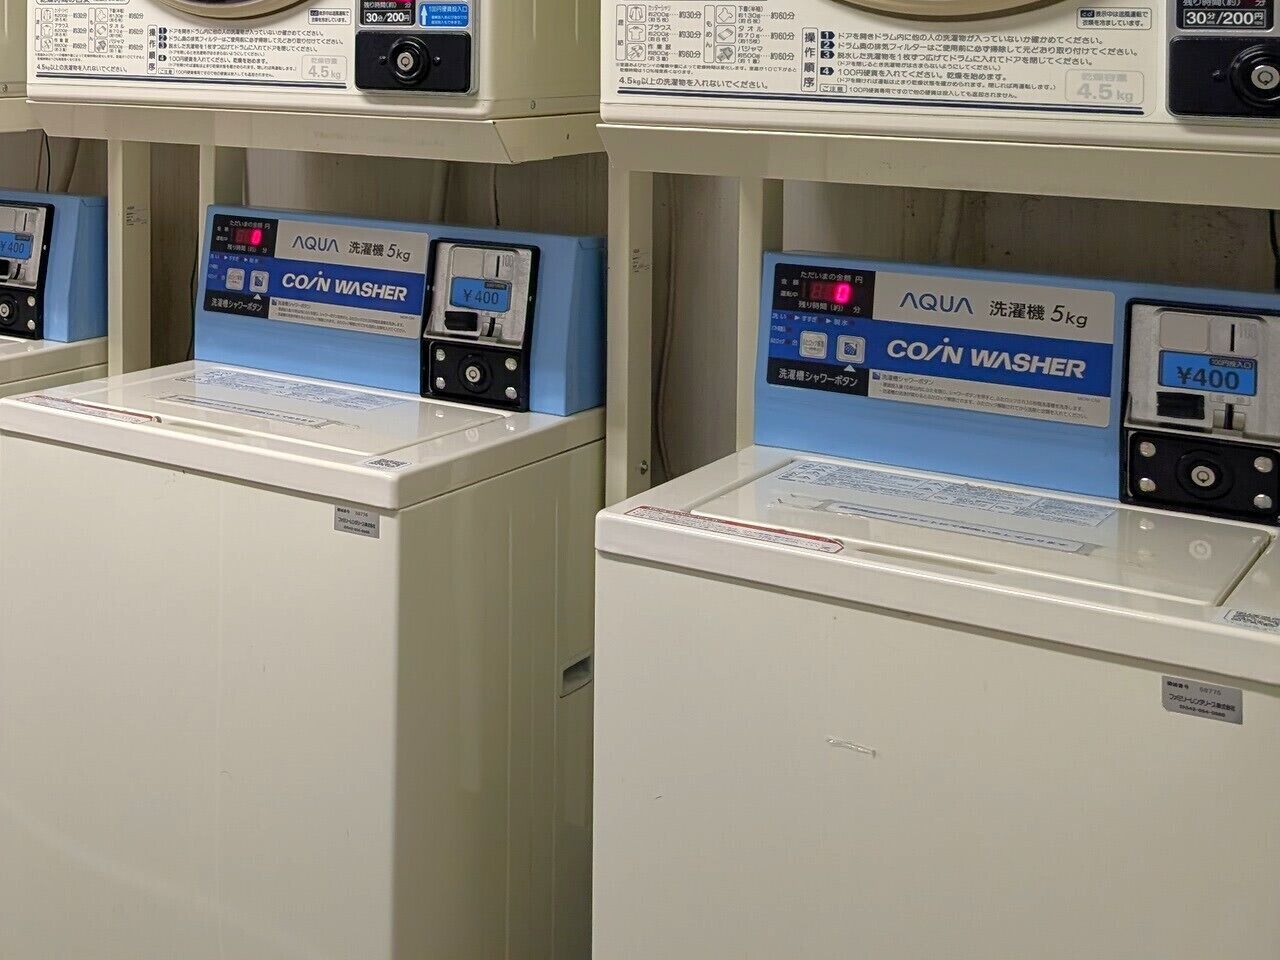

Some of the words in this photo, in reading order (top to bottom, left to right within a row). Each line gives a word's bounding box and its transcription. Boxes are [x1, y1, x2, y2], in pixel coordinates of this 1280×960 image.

[678, 11, 702, 19] 約30分
[678, 31, 702, 39] 約30分
[803, 32, 816, 88] 操作順序
[308, 66, 330, 78] 4.5
[330, 71, 342, 80] kg
[618, 76, 768, 90] 4.5kg以上の洗濯物を入れないでください。
[1077, 83, 1114, 100] 4.5
[1116, 90, 1134, 103] kg
[293, 235, 339, 253] AQUA
[348, 240, 384, 258] 洗濯機
[387, 244, 411, 263] 5kg
[855, 275, 864, 284] 円
[334, 279, 408, 302] WASHER
[836, 283, 852, 304] 0
[852, 306, 862, 314] 分
[899, 292, 974, 315] AQUA
[989, 300, 1045, 321] 洗濯機
[1050, 304, 1089, 329] 5kg
[970, 347, 1086, 380] WASHER
[1176, 365, 1240, 390] ¥400
